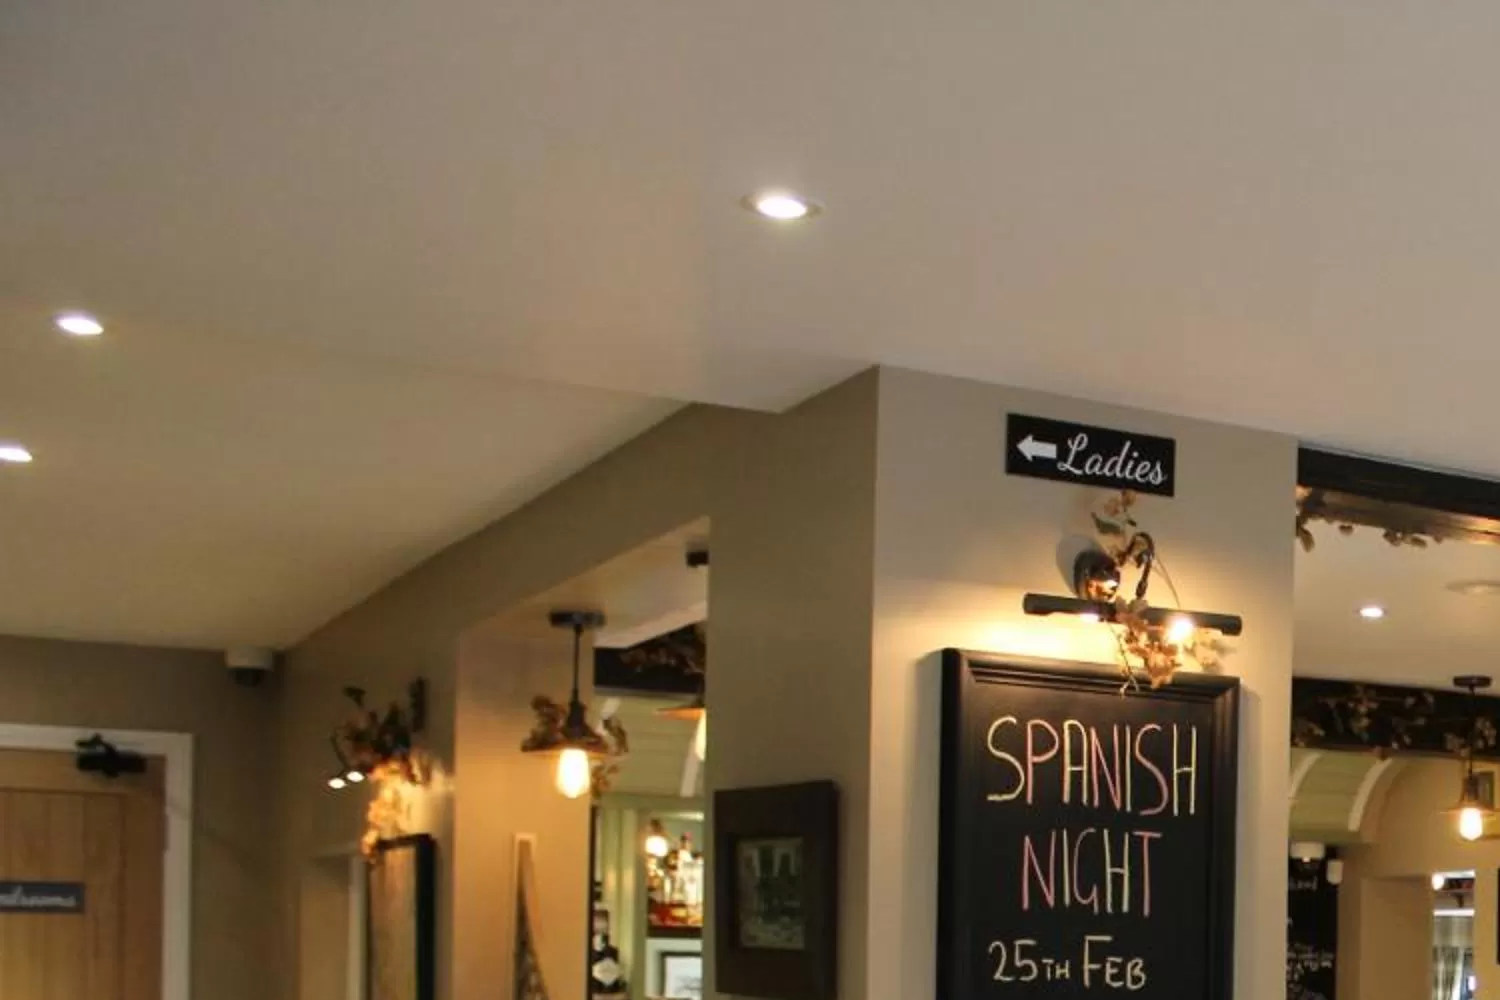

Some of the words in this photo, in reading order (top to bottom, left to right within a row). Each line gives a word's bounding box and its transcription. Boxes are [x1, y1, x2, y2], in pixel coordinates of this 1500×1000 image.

[1057, 433, 1168, 485] Ladies
[987, 716, 1198, 816] SPANISH
[1022, 828, 1162, 917] NIGHT
